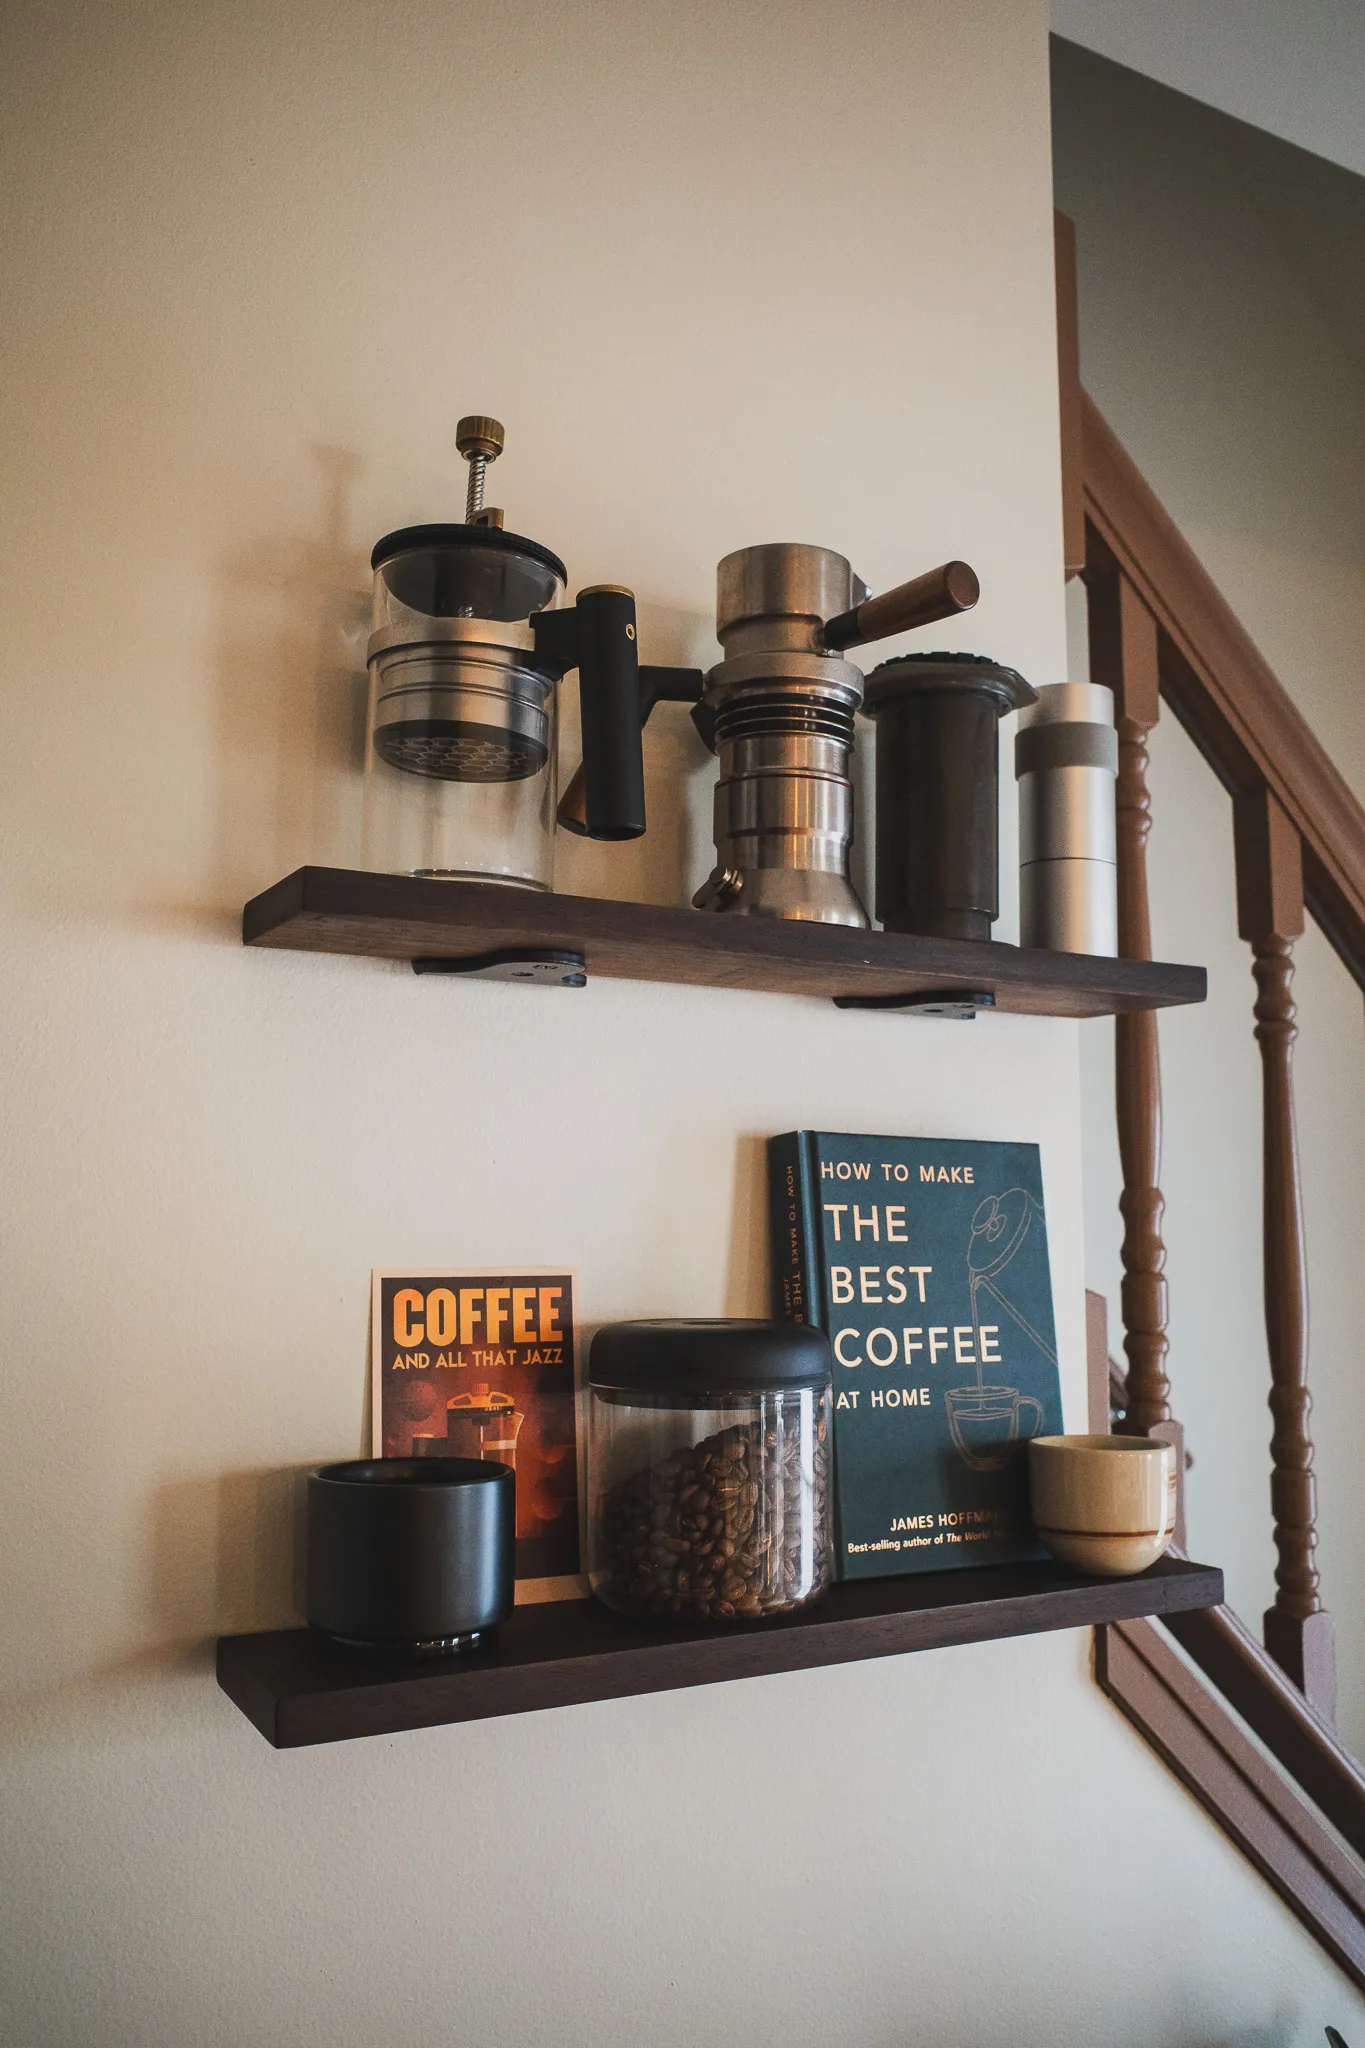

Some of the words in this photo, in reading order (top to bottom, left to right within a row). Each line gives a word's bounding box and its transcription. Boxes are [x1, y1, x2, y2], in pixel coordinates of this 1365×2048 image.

[786, 1165, 795, 1197] HOW
[820, 1161, 871, 1180] HOW
[880, 1163, 909, 1182] TO
[919, 1165, 975, 1184] MAKE
[788, 1203, 796, 1221] TO
[823, 1204, 909, 1242] THE
[790, 1228, 799, 1265] MAKE
[791, 1270, 802, 1306] THE
[830, 1265, 933, 1304] BEST
[393, 1287, 563, 1348] COFFEE
[392, 1352, 430, 1370] AND
[435, 1351, 467, 1368] ALL
[472, 1350, 516, 1367] THAT
[522, 1348, 563, 1365] JAZZ
[833, 1325, 1002, 1368] COFFEE
[836, 1391, 860, 1409] AT
[871, 1387, 931, 1408] HOME
[890, 1514, 934, 1532] JAMES
[848, 1539, 900, 1553] Best-selling
[902, 1536, 932, 1548] author
[934, 1533, 944, 1545] of
[946, 1532, 962, 1543] The
